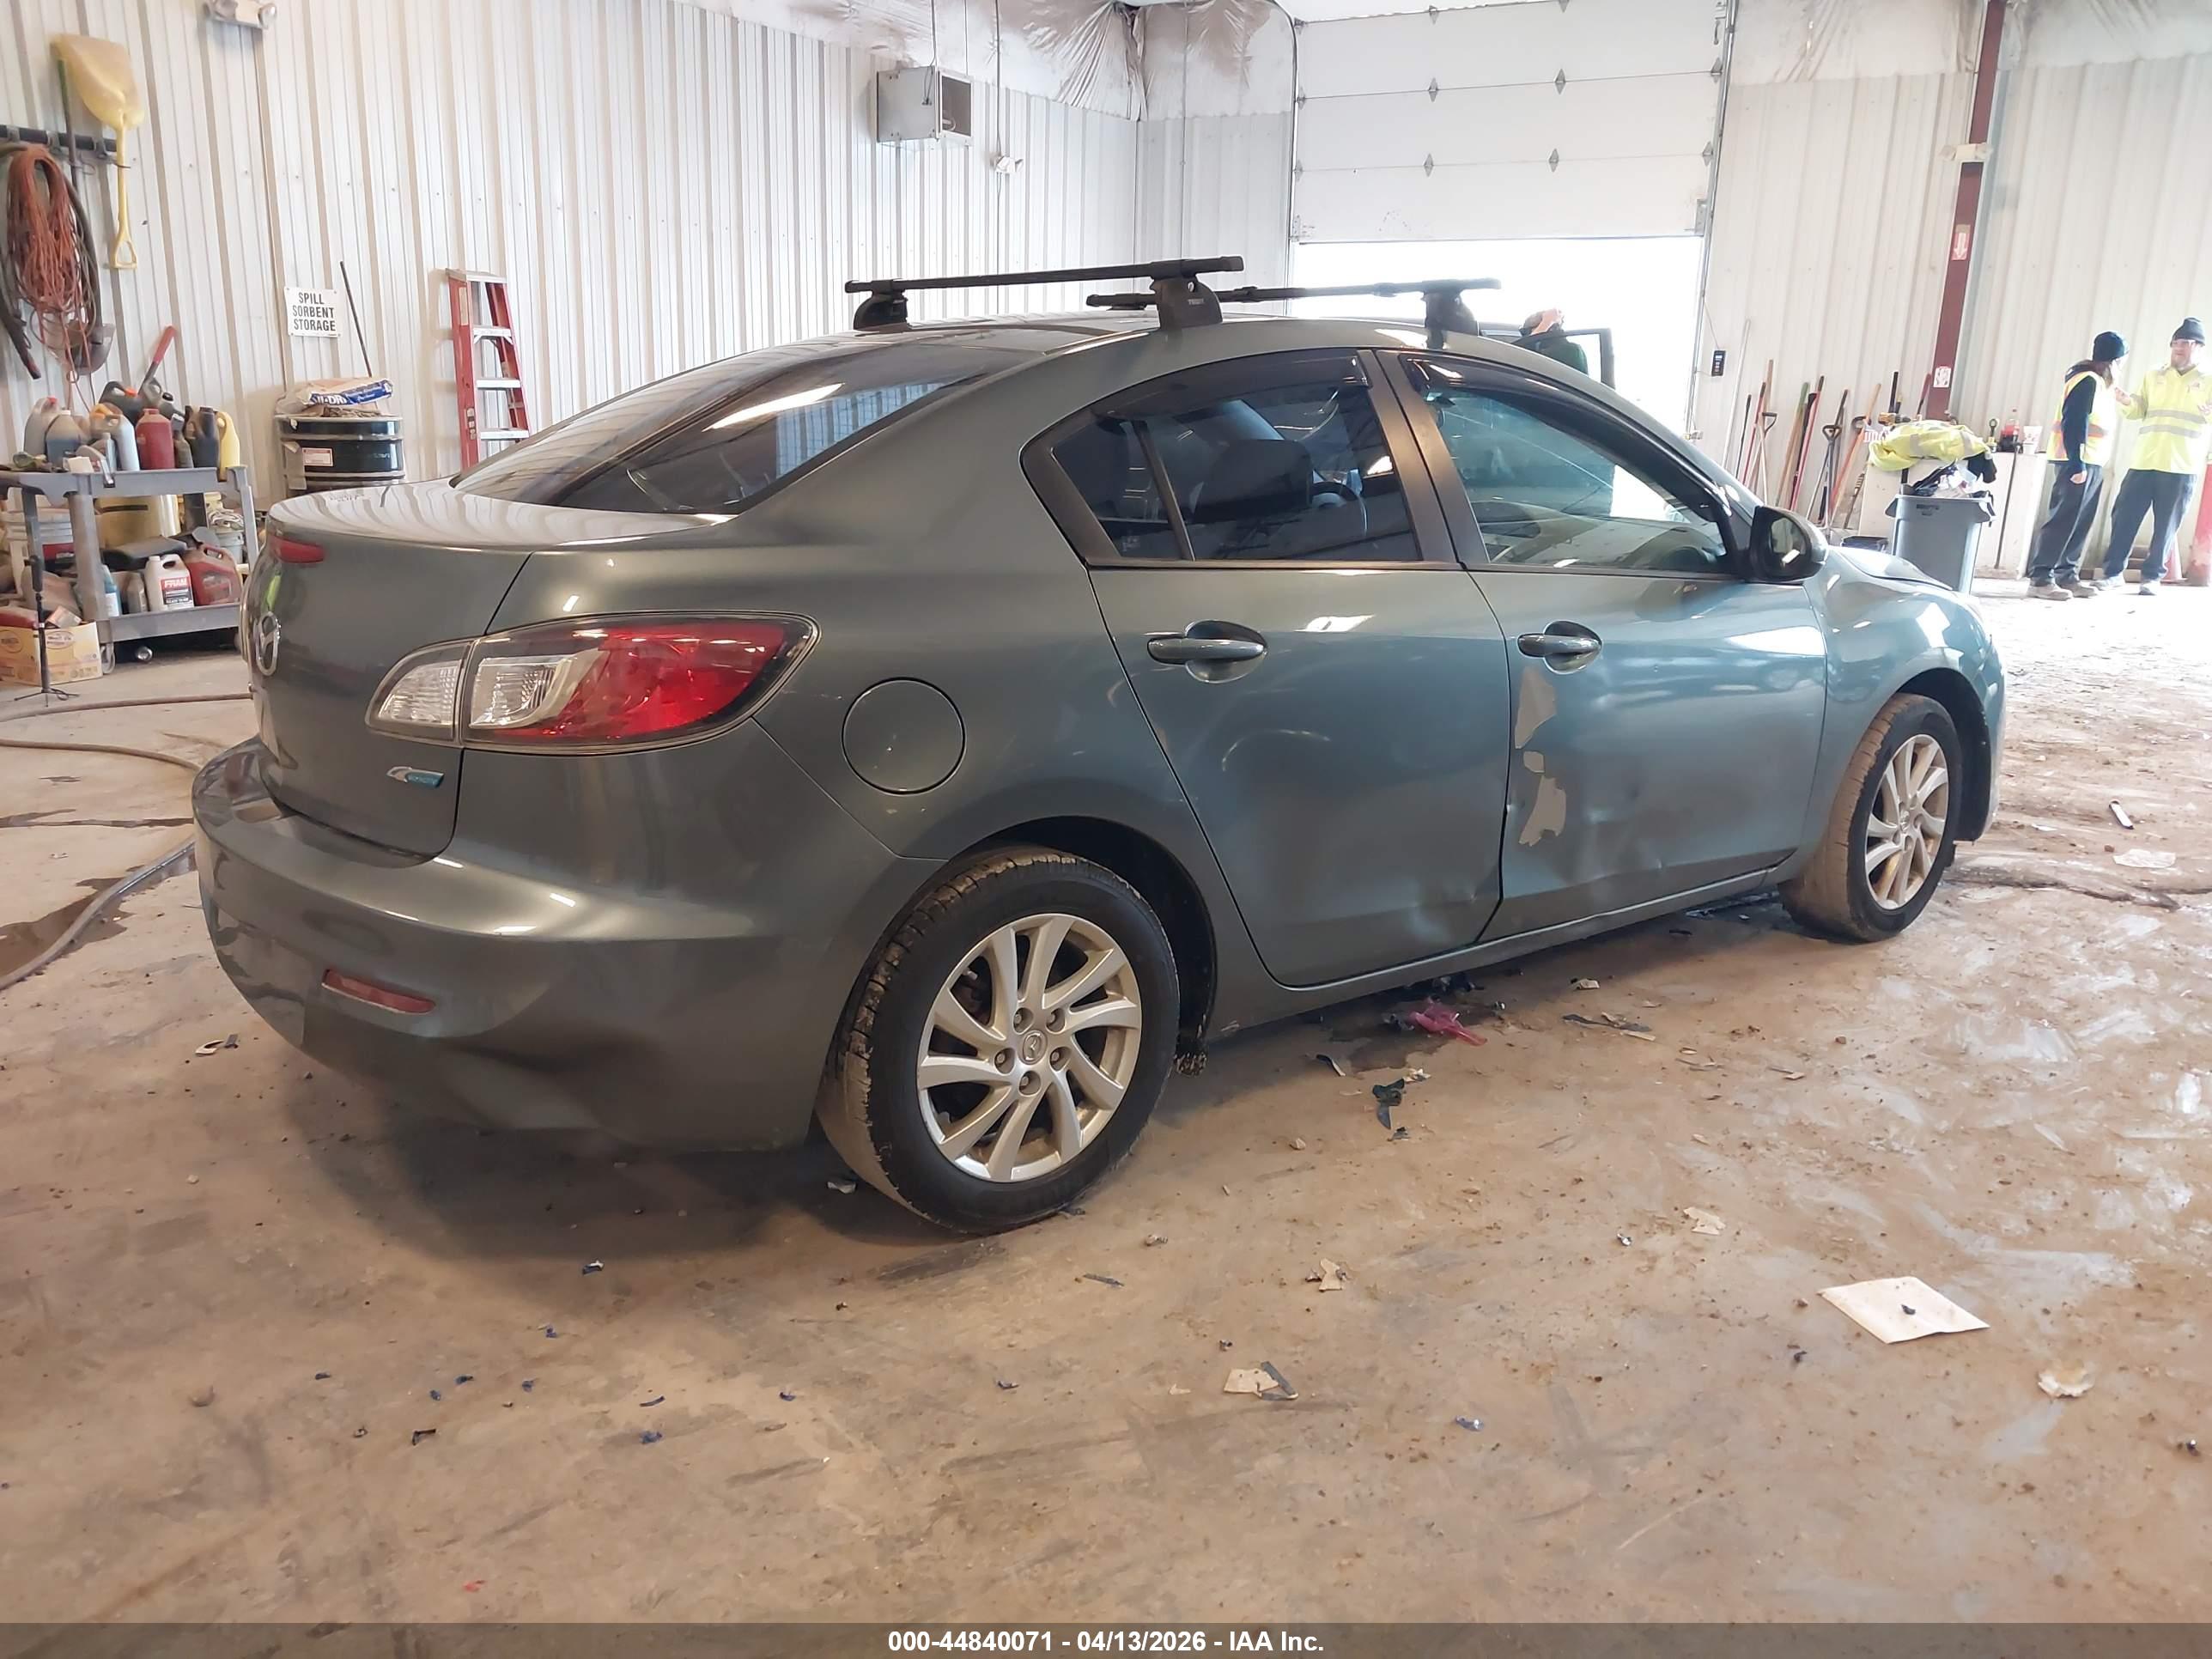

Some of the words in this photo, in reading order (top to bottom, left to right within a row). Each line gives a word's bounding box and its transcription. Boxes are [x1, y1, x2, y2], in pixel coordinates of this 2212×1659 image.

[298, 292, 325, 305] SPILL
[292, 305, 334, 319] SORBENT
[294, 319, 336, 331] STORAGE
